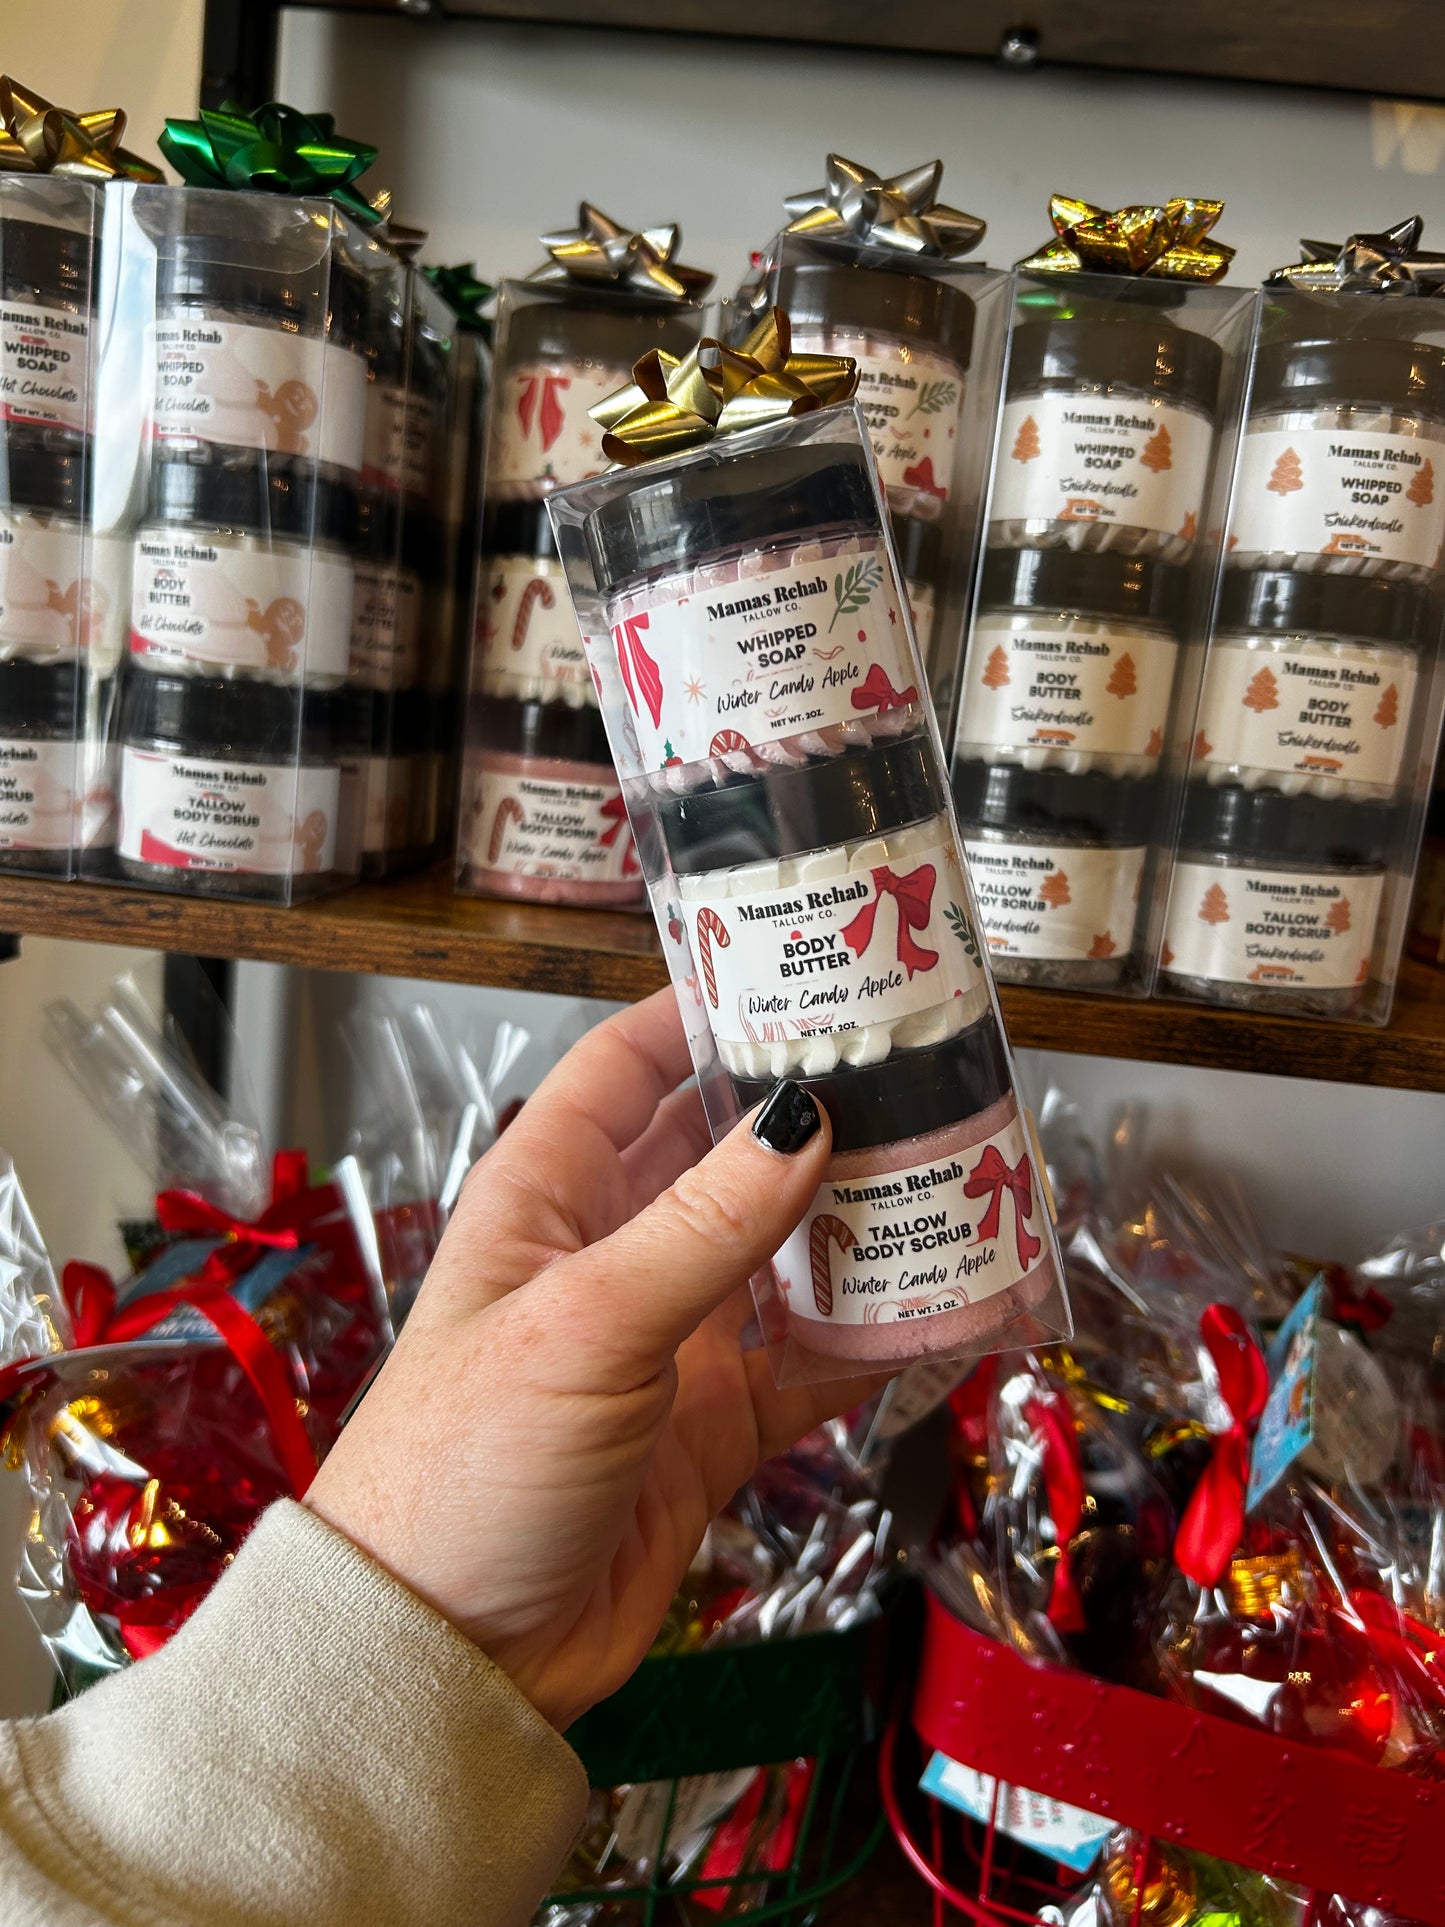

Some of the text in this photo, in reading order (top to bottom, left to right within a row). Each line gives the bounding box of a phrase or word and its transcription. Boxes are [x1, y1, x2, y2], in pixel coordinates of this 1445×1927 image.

[14, 325, 46, 336] TALLOW
[44, 316, 88, 336] Rehab
[183, 329, 222, 344] Rehab
[5, 341, 71, 362] WHIPPED
[17, 357, 57, 373] SOAP
[157, 361, 204, 373] WHIPPED
[163, 375, 192, 386] SOAP
[21, 380, 79, 402] Chocolate
[165, 398, 211, 413] Chocolate
[1062, 412, 1156, 431] Mamas Rehab
[1074, 443, 1135, 459] WHIPPED
[1328, 445, 1422, 466] Mamas Rehab
[1084, 457, 1122, 471] SOAP
[1353, 460, 1384, 469] TALLOW
[1059, 477, 1138, 498] Snickerdoodle
[1341, 477, 1403, 494] WHIPPED
[1351, 492, 1389, 506] SOAP
[1323, 512, 1404, 533] Snickerdoodle
[174, 544, 218, 562] Rehab
[154, 578, 186, 591] BODY
[149, 592, 191, 607] BUTTER
[706, 576, 828, 622] Mamas Rehab
[742, 602, 802, 624] TALLOW CO.
[155, 616, 203, 635] Chocolate
[737, 622, 817, 655] WHIPPED
[1012, 638, 1110, 657] Mamas Rehab
[757, 644, 806, 668] SOAP
[1036, 672, 1077, 686] BODY
[1282, 661, 1381, 686] Mamas Rehab
[717, 663, 860, 714] Winter Candy Apple
[1029, 685, 1081, 701] BUTTER
[1308, 698, 1349, 713] BODY
[770, 709, 825, 729] NET WT. 2OZ.
[1010, 706, 1094, 726] Snickerdoodle
[1299, 711, 1352, 729] BUTTER
[1278, 730, 1361, 755] Snickerdoodle
[173, 765, 267, 786] Mamas Rehab
[189, 796, 246, 812] TALLOW
[174, 808, 260, 828] BODY SCRUB
[533, 811, 585, 827] TALLOW
[176, 829, 254, 850] Hot Chocolate
[520, 821, 597, 840] BODY SCRUB
[967, 852, 1054, 871] Mamas Rehab
[979, 883, 1032, 898] TALLOW
[1246, 879, 1340, 898] Mamas Rehab
[737, 880, 869, 922] Mamas Rehab
[1001, 898, 1046, 911] SCRUB
[773, 909, 837, 929] TALLOW CO.
[1263, 911, 1319, 926] TALLOW
[1245, 923, 1331, 940] BODY SCRUB
[783, 934, 837, 959] BODY
[1245, 943, 1324, 963] Snickerdoodle
[779, 952, 851, 978] BUTTER
[749, 970, 904, 1015] Winter Candy Apple
[800, 1021, 860, 1038] NET WT. 2OZ.
[832, 1161, 964, 1205] Mamas Rehab
[870, 1191, 935, 1212] TALLOW CO.
[868, 1210, 947, 1242] TALLOW
[853, 1222, 972, 1262] BODY SCRUB
[842, 1247, 997, 1296] Winter Candy Apple
[898, 1299, 959, 1319] NET WT. 2 OZ.
